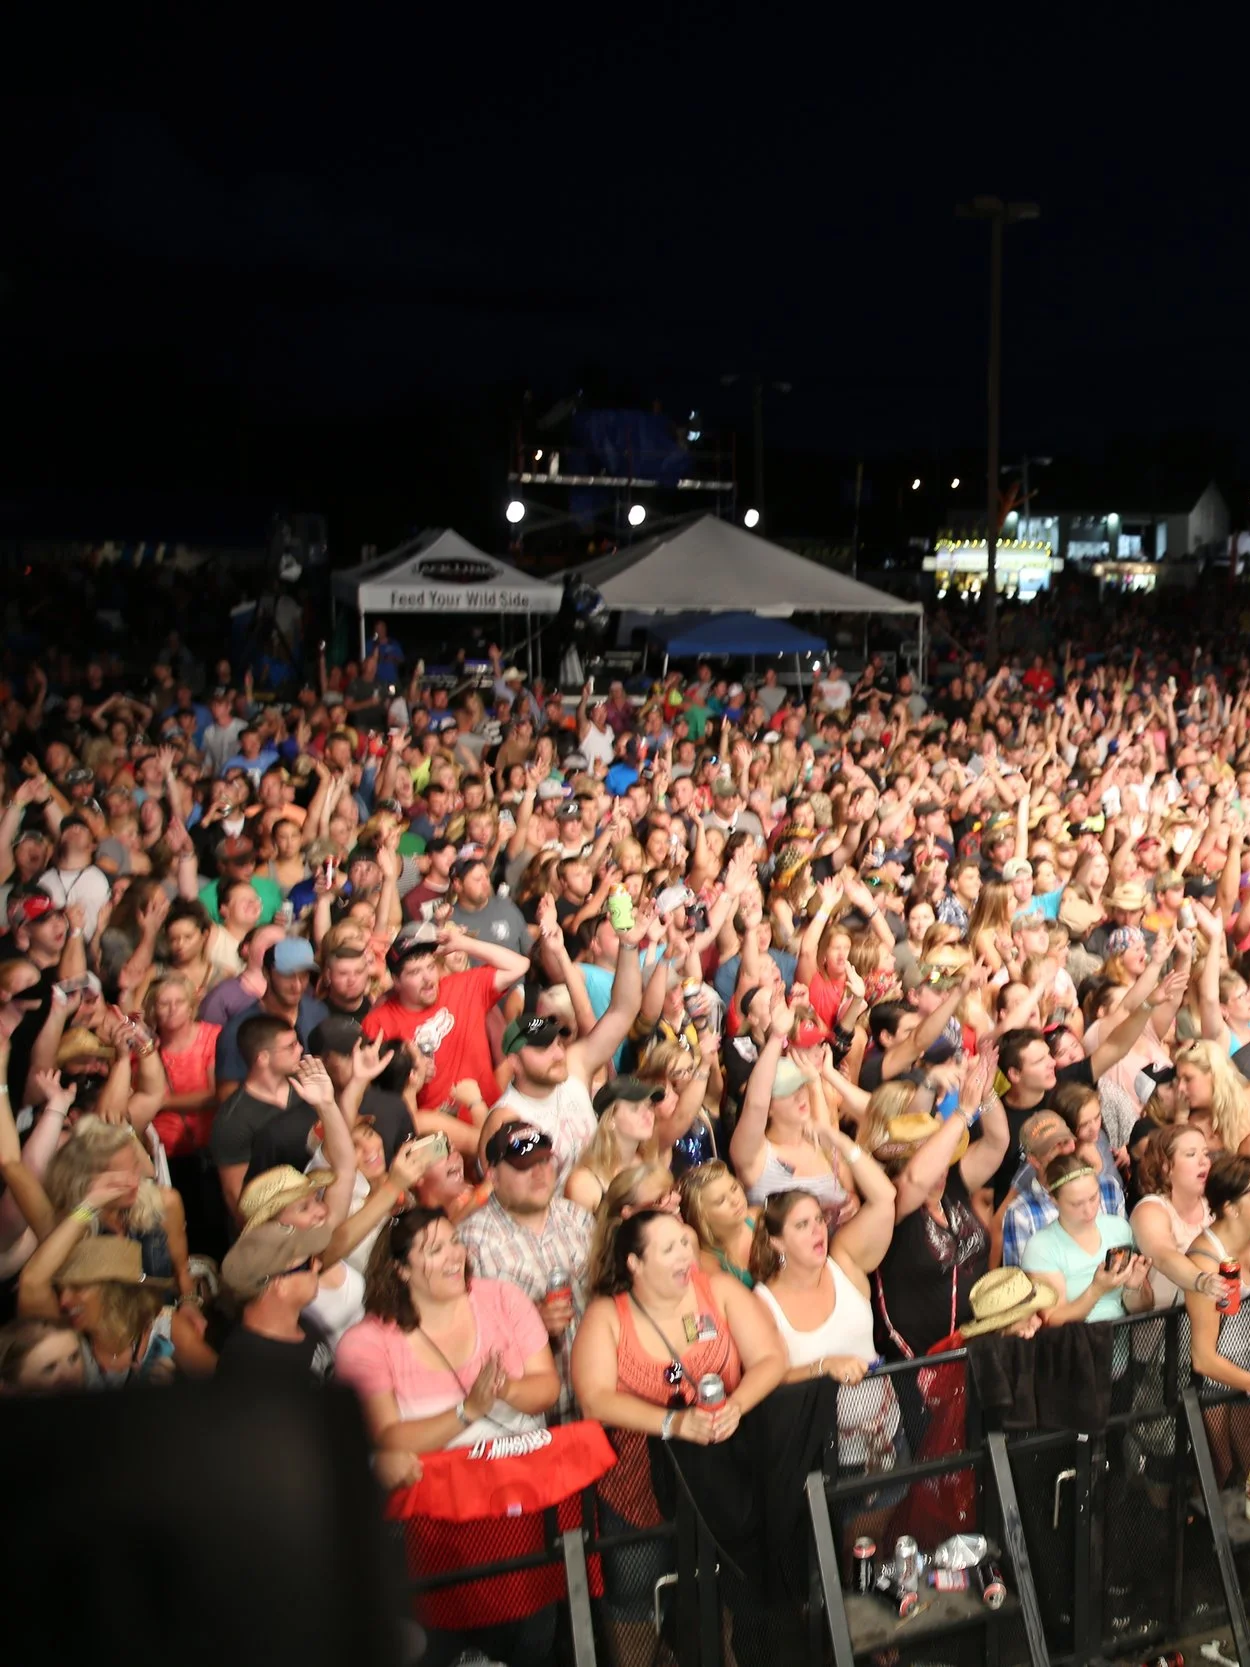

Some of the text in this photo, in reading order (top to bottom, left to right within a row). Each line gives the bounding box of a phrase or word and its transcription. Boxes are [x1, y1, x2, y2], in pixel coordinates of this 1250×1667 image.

[391, 589, 530, 607] Feed Your Wild Side
